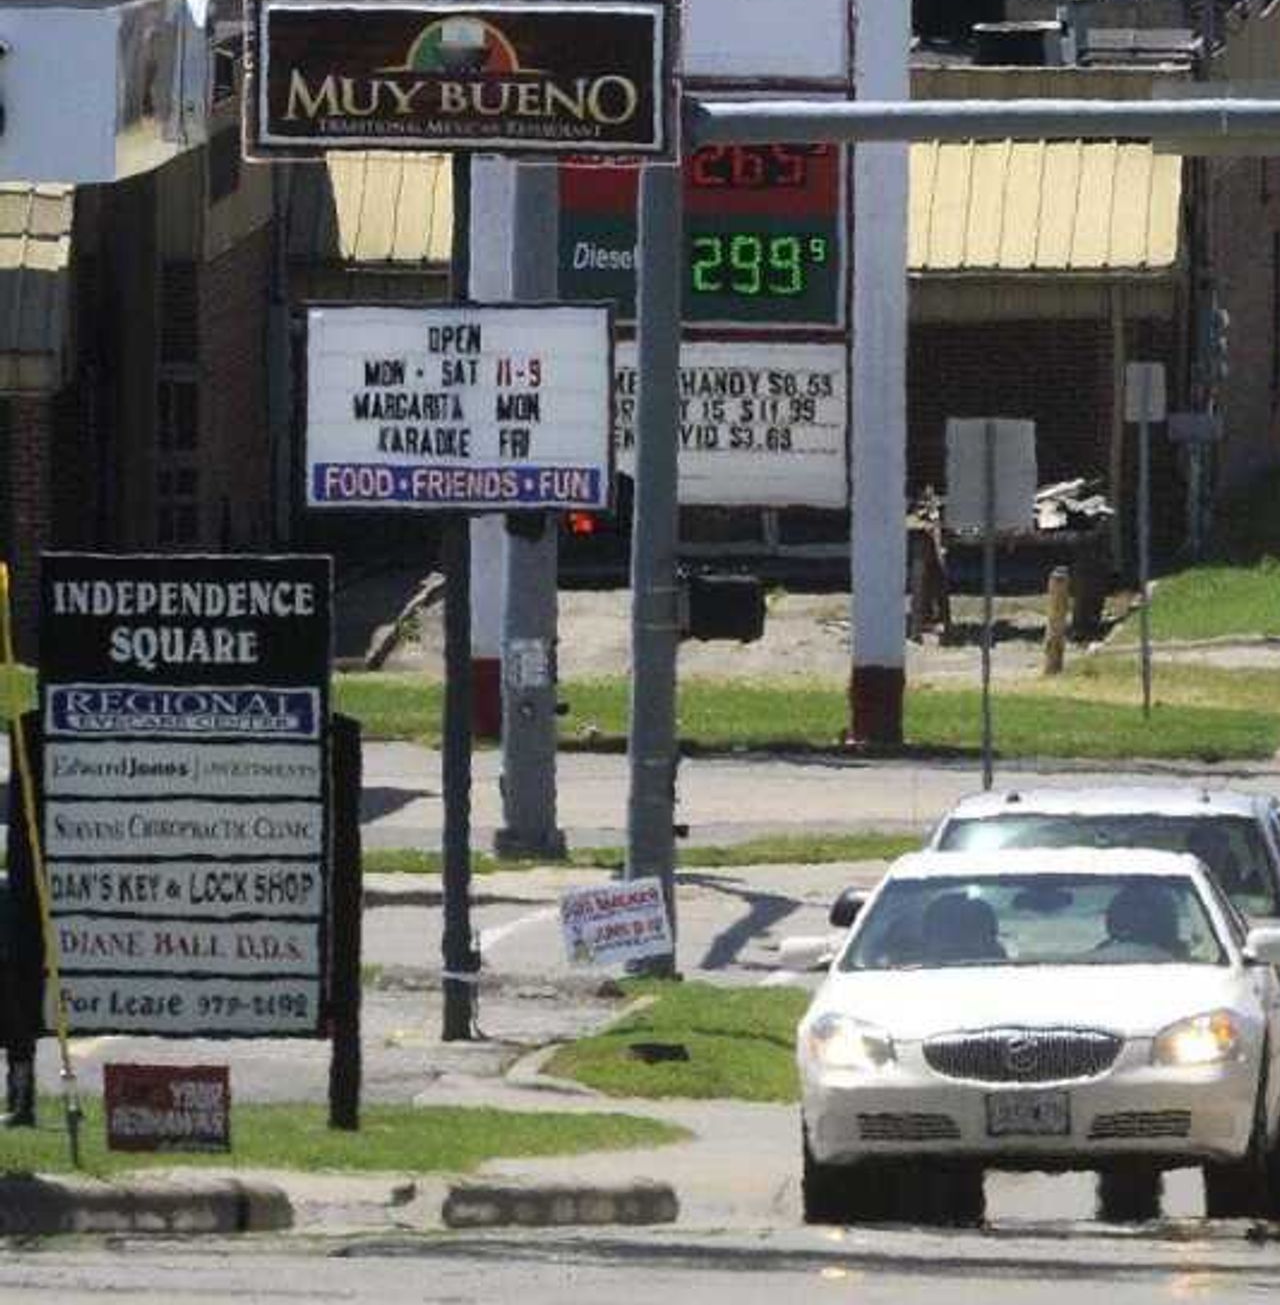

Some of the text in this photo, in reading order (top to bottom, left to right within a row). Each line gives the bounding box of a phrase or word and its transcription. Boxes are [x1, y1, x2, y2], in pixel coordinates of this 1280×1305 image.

[284, 67, 638, 125] MUY BUENO
[428, 325, 481, 352] OPEN
[364, 359, 405, 387] MON
[441, 359, 479, 387] SAT
[679, 371, 761, 396] HANDY
[354, 392, 541, 422] MARGARITA MON
[377, 428, 531, 458] KARAOKE FRI
[325, 466, 591, 499] FOOD FRIENDS FUN
[53, 581, 315, 617] INDEPENDENCE
[110, 626, 259, 671] SQUARE
[66, 691, 291, 715] REGIONAL
[51, 873, 112, 902] DAN'S
[118, 874, 159, 904] KEY
[189, 873, 249, 904] LOCK
[254, 872, 313, 904] SHOP
[59, 929, 146, 957] DIANE
[110, 990, 185, 1017] Lease
